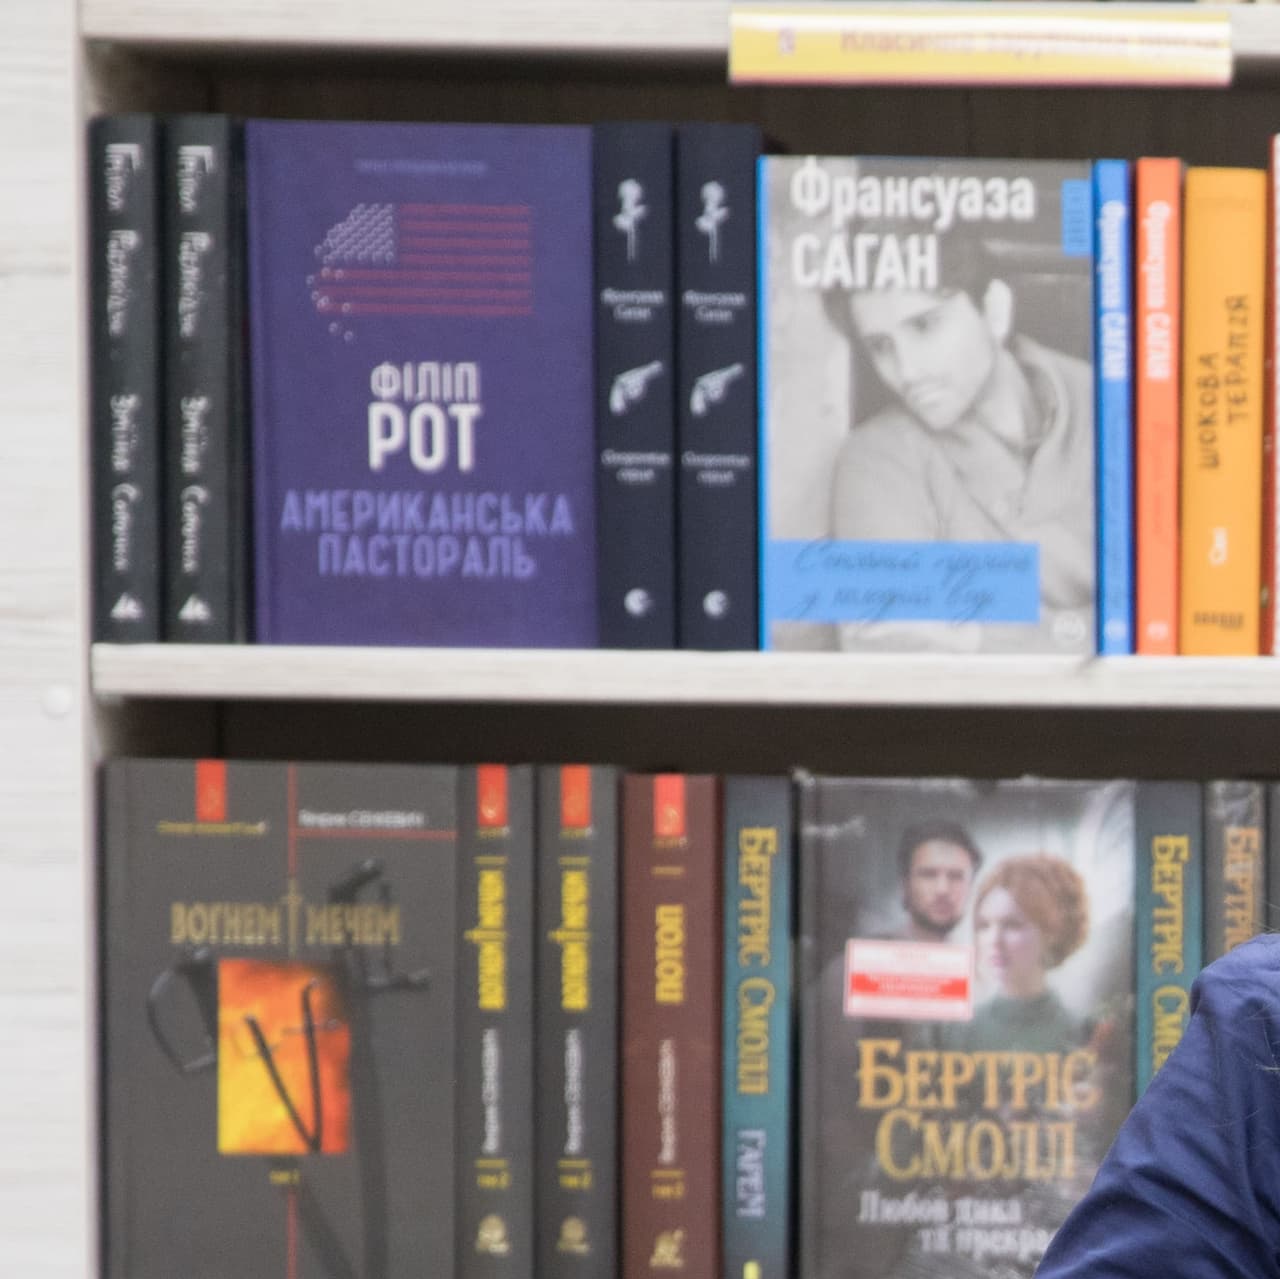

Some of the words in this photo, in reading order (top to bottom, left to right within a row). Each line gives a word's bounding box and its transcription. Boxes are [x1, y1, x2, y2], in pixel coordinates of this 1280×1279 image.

[790, 156, 1035, 232] Франсуаза
[792, 232, 940, 290] САГАН
[369, 361, 478, 402] ФІЛІП
[368, 402, 481, 472] РОТ
[280, 489, 575, 535] АМЕРИКАНСЬКА
[317, 533, 537, 579] ПАСТОРАЛЬ
